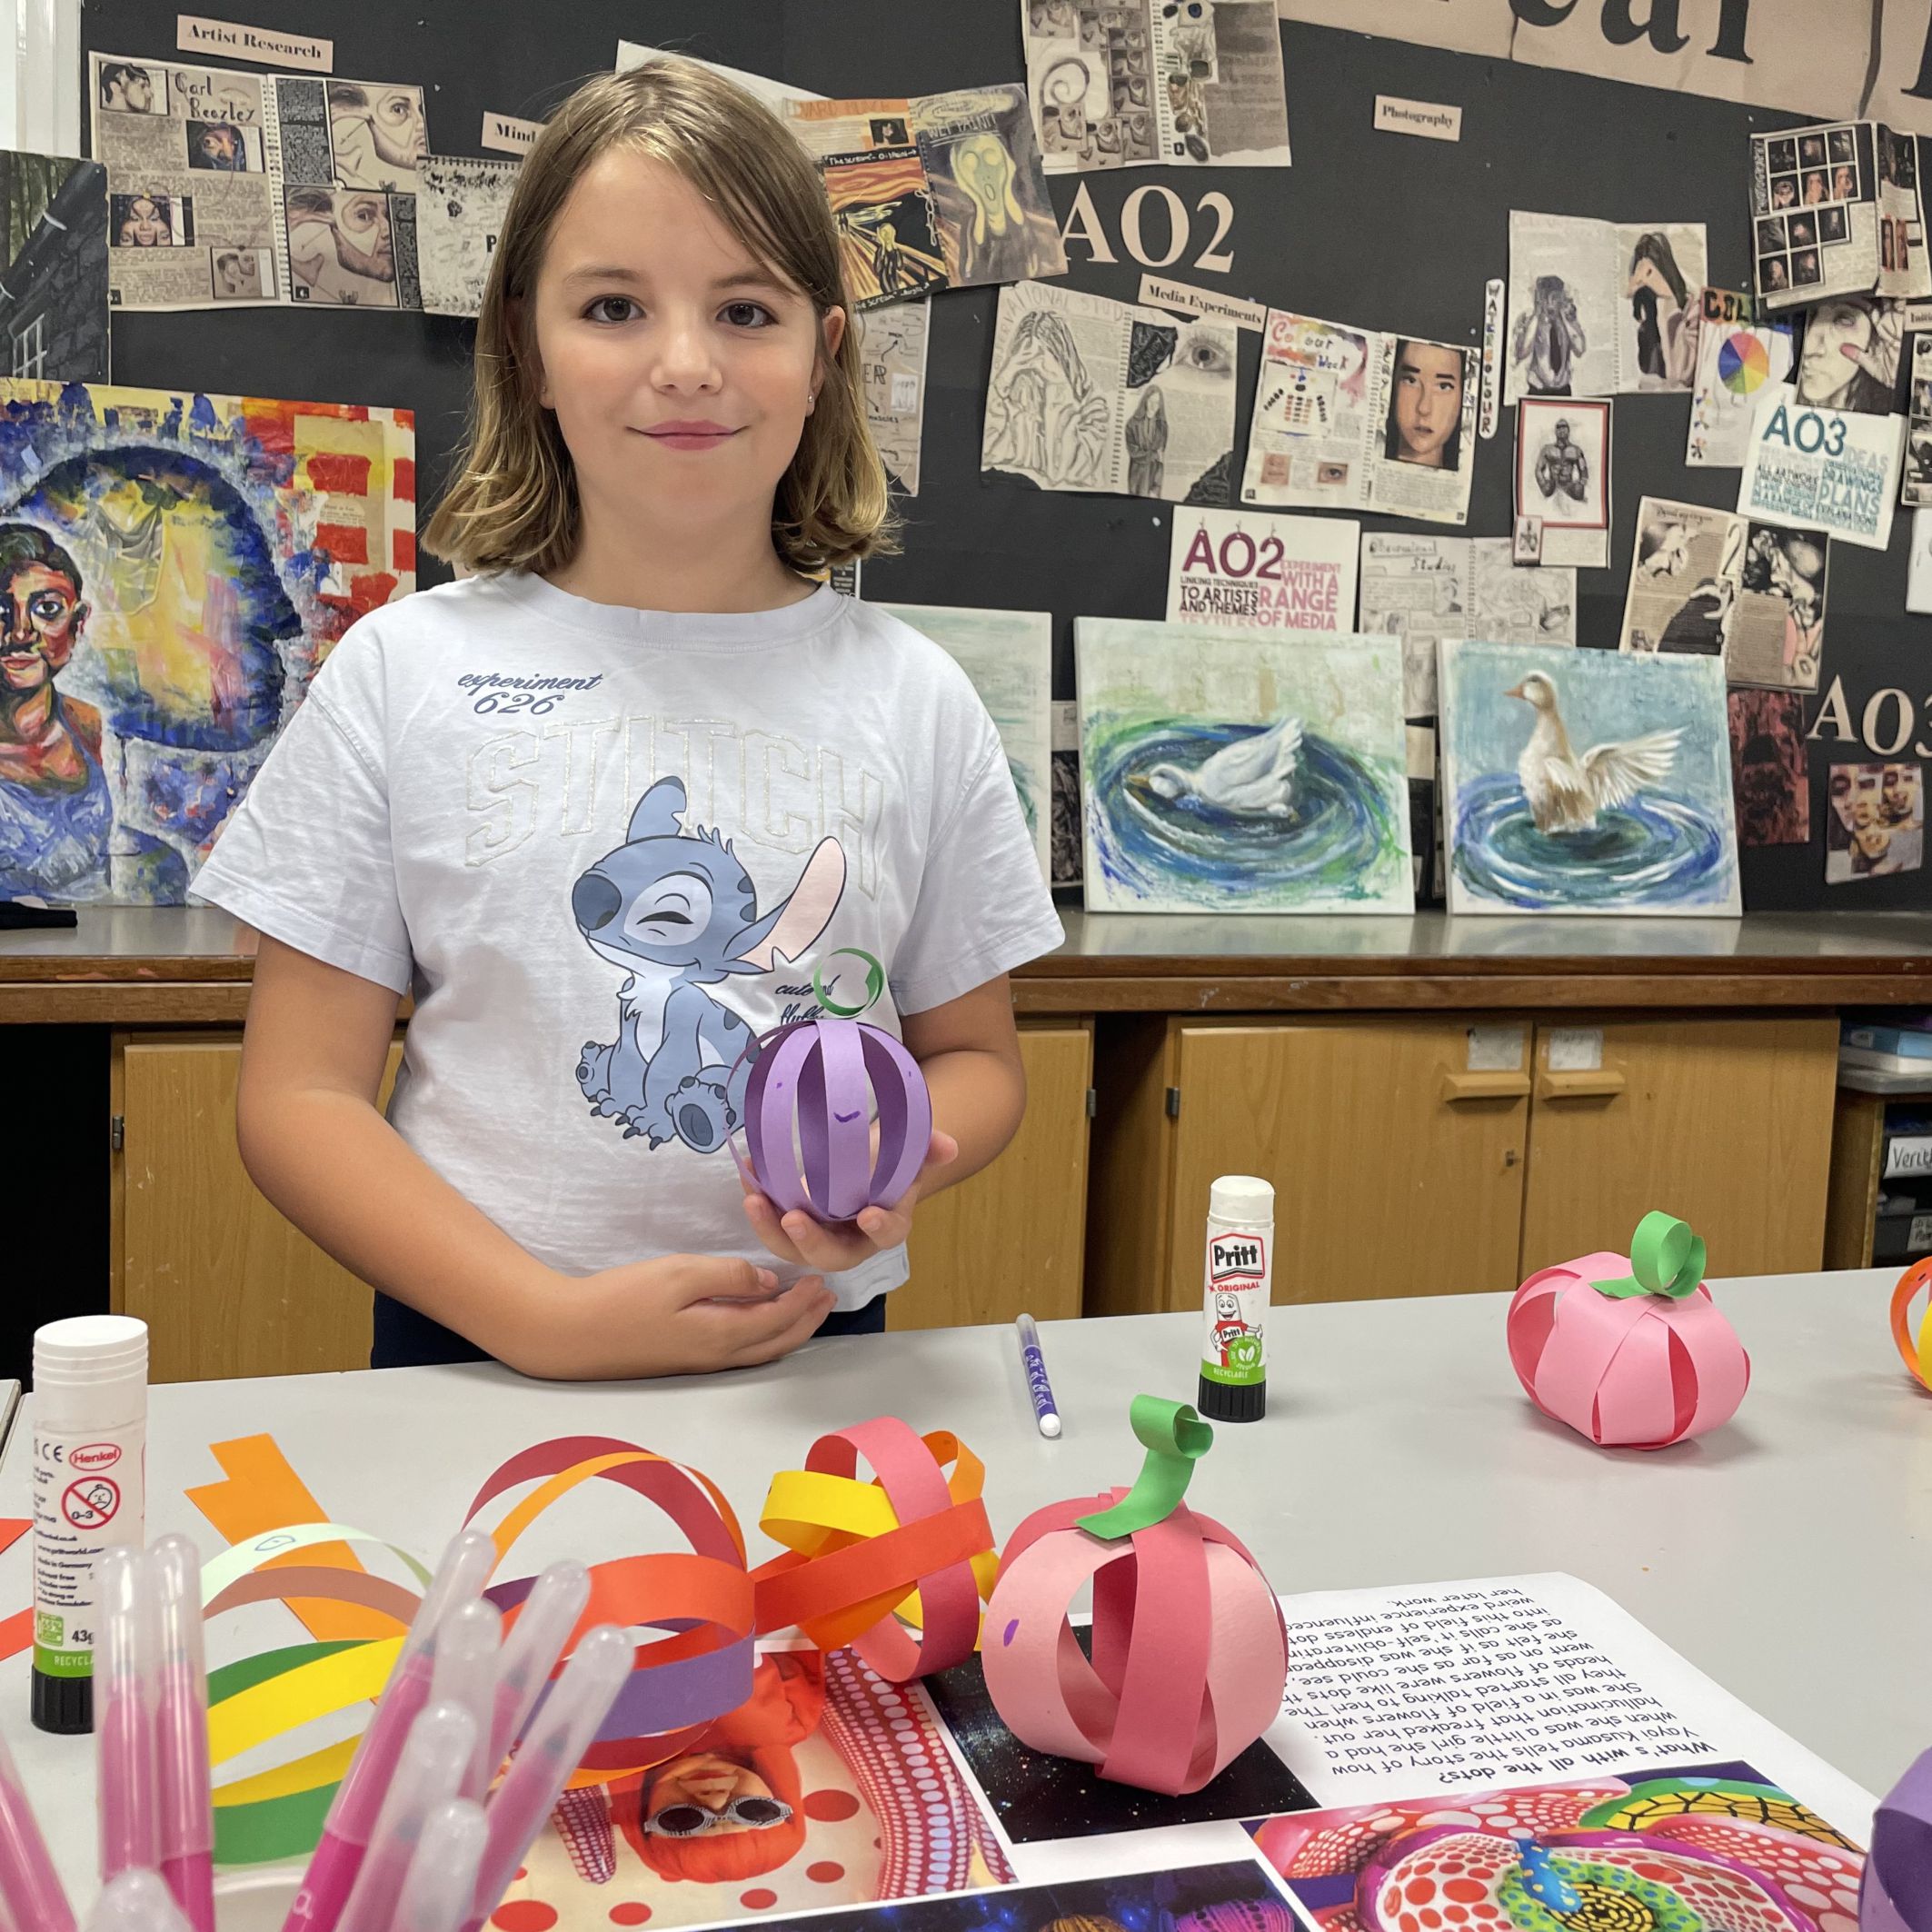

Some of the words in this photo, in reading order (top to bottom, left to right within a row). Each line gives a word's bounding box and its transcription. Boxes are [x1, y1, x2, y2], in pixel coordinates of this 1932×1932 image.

[189, 24, 237, 45] Artist
[244, 33, 322, 59] Research
[1382, 105, 1453, 129] Photography
[495, 122, 536, 143] Mind
[1061, 181, 1235, 273] AO2
[1149, 284, 1186, 304] Media
[1189, 294, 1262, 324] Experiments
[1762, 404, 1847, 456] AO3
[1182, 529, 1285, 580] AO2
[1281, 571, 1324, 589] WITH
[1328, 573, 1339, 589] A
[1180, 585, 1200, 600] TO
[1202, 587, 1259, 604] ARTISTS
[1258, 586, 1339, 612] RANGE
[1180, 600, 1207, 613] AND
[1209, 602, 1258, 616] THEMES
[1257, 610, 1285, 626] OF
[1285, 612, 1338, 632] MEDIA
[457, 672, 603, 696] experiment
[473, 692, 565, 715] 626
[464, 715, 884, 901] STITCH
[1214, 1244, 1258, 1267] Pritt
[1218, 1281, 1260, 1293] ORIGINAL
[1222, 1328, 1240, 1339] Pritt
[1213, 1367, 1249, 1379] RECYCLABLE
[74, 1449, 117, 1464] Henkel
[72, 1509, 95, 1520] 0-3
[1442, 1592, 1488, 1602] later
[1490, 1588, 1523, 1598] her
[1387, 1597, 1437, 1608] work.
[1483, 1597, 1535, 1611] weird
[1379, 1604, 1480, 1620] experience
[1471, 1612, 1509, 1624] this
[1512, 1608, 1549, 1618] into
[1399, 1622, 1419, 1634] of
[1423, 1617, 1469, 1631] field
[1504, 1621, 1539, 1632] she
[1540, 1618, 1563, 1628] as
[1324, 1626, 1394, 1641] endless
[1440, 1631, 1456, 1641] it
[1459, 1627, 1501, 1639] calls
[1543, 1630, 1578, 1641] she
[1288, 1635, 1320, 1646] dot
[1288, 1634, 1439, 1658] 'self-obliteratin
[1478, 1640, 1500, 1650] as
[1505, 1634, 1542, 1648] felt
[1418, 1646, 1454, 1658] she
[1459, 1643, 1475, 1655] if
[1519, 1648, 1544, 1658] on
[1549, 1642, 1595, 1656] went
[1379, 1650, 1417, 1663] was
[1461, 1655, 1493, 1667] far
[1495, 1652, 1518, 1662] as
[1553, 1655, 1613, 1669] heads
[1287, 1656, 1375, 1673] disappear
[1393, 1663, 1429, 1676] she
[1433, 1660, 1456, 1670] as
[1529, 1662, 1549, 1675] of
[1291, 1675, 1334, 1686] see,
[1338, 1668, 1389, 1685] could
[1449, 1665, 1524, 1684] flowers
[1553, 1673, 1577, 1686] all
[1581, 1668, 1627, 1680] they
[1356, 1683, 1396, 1696] like
[1396, 1677, 1447, 1689] were
[1474, 1677, 1550, 1698] started
[1601, 1682, 1643, 1695] She
[1281, 1693, 1303, 1705] th
[1306, 1688, 1352, 1700] dots
[1401, 1688, 1473, 1704] talking
[1538, 1691, 1562, 1701] in
[1562, 1686, 1601, 1698] was
[1377, 1698, 1401, 1708] to
[1470, 1697, 1521, 1715] field
[1521, 1695, 1536, 1704] a
[1284, 1706, 1329, 1718] The
[1332, 1700, 1376, 1715] her!
[1446, 1705, 1468, 1718] of
[1536, 1697, 1663, 1718] hallucination
[1303, 1717, 1359, 1730] when
[1362, 1708, 1440, 1725] flowers
[1489, 1712, 1535, 1728] that
[1585, 1716, 1623, 1728] she
[1624, 1711, 1678, 1725] when
[1363, 1728, 1402, 1740] her
[1401, 1718, 1486, 1739] freaked
[1525, 1728, 1540, 1737] a
[1543, 1720, 1584, 1735] was
[1640, 1725, 1699, 1738] Yayoi
[1430, 1734, 1467, 1752] girl
[1470, 1730, 1528, 1747] little
[1560, 1730, 1640, 1748] Kusama
[1325, 1750, 1339, 1759] a
[1344, 1746, 1389, 1760] had
[1388, 1741, 1427, 1755] she
[1511, 1742, 1560, 1758] tells
[1635, 1741, 1718, 1758] What's
[1409, 1753, 1466, 1768] story
[1469, 1749, 1509, 1762] the
[1580, 1748, 1630, 1766] with
[1331, 1763, 1378, 1776] how
[1380, 1759, 1403, 1774] of
[1503, 1761, 1544, 1775] the
[1548, 1758, 1575, 1772] all
[1439, 1768, 1497, 1784] dots?
